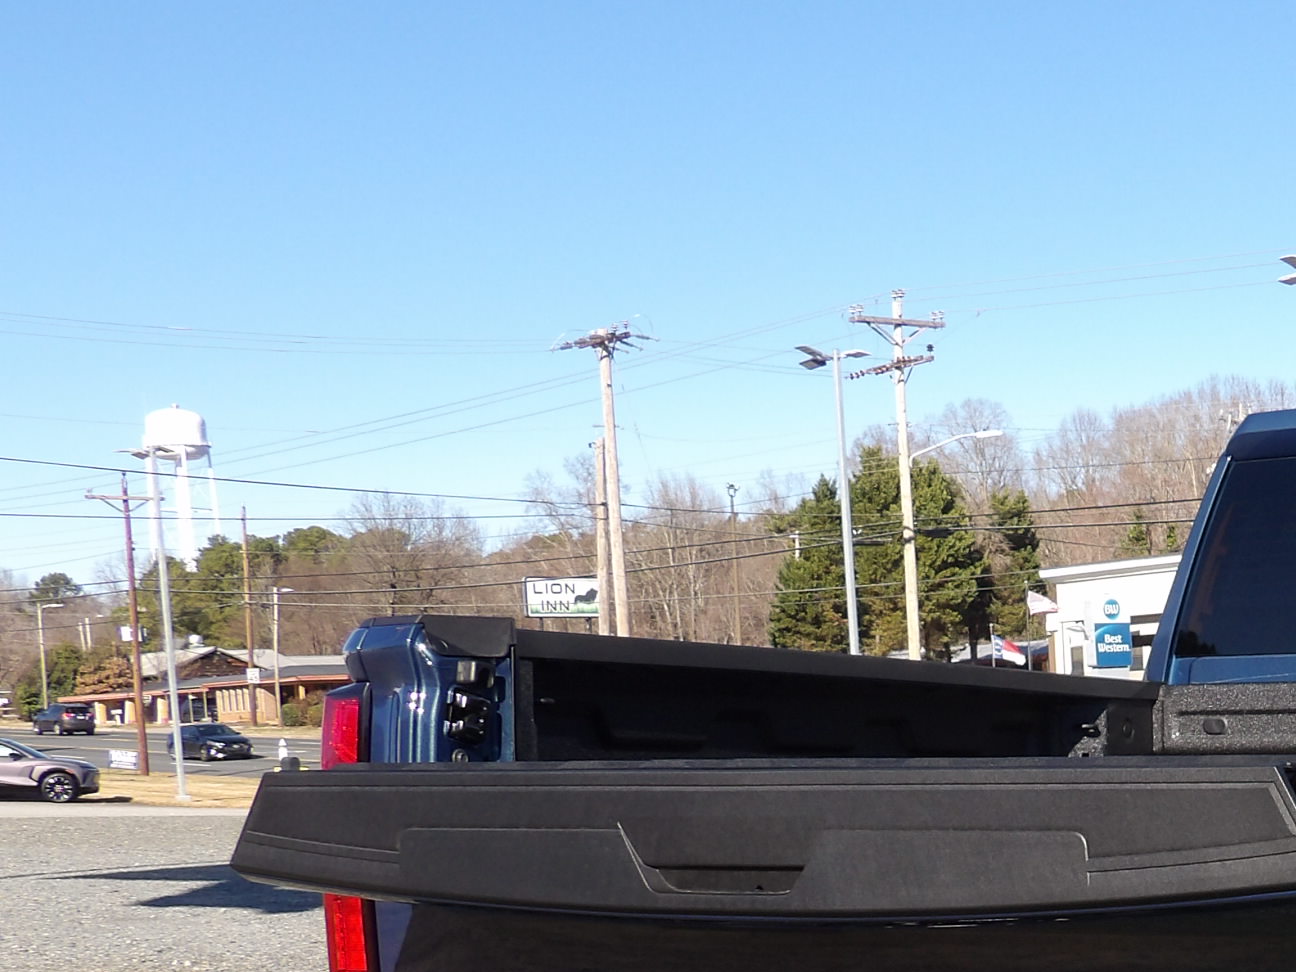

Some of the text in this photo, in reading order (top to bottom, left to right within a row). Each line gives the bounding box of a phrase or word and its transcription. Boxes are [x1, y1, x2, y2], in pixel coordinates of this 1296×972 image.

[533, 583, 575, 594] LION
[541, 600, 570, 611] INN
[1104, 634, 1122, 643] Best
